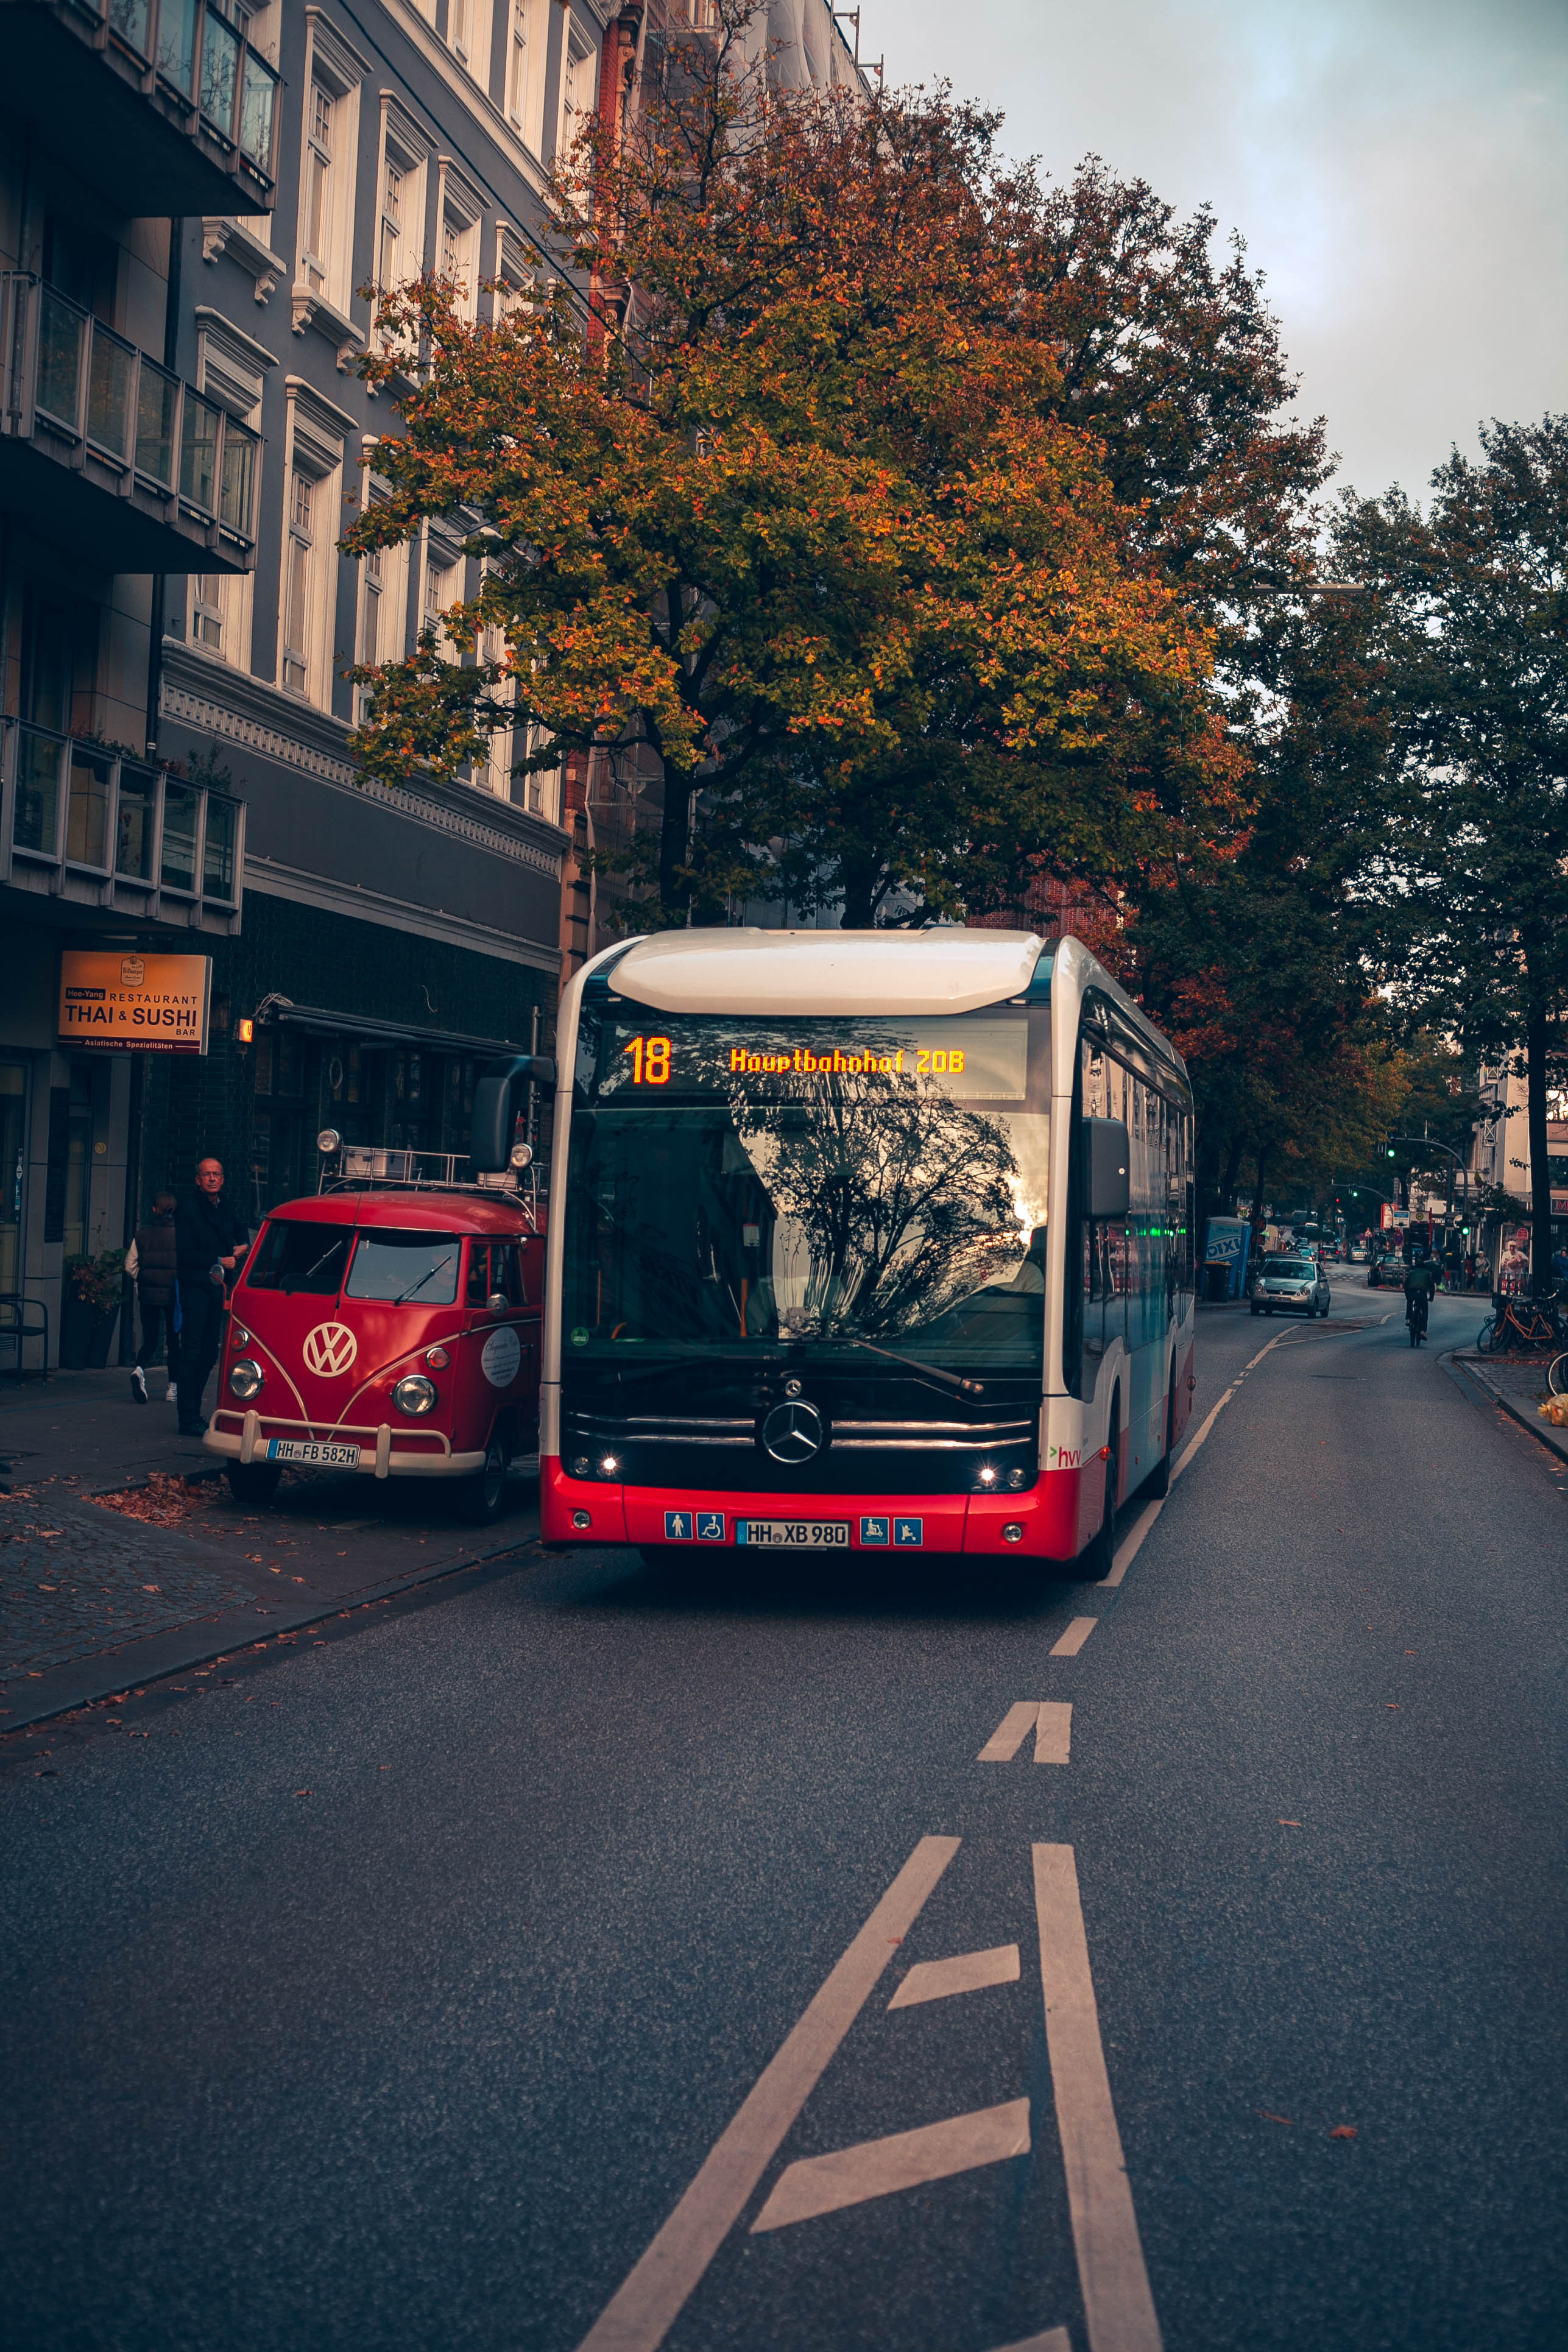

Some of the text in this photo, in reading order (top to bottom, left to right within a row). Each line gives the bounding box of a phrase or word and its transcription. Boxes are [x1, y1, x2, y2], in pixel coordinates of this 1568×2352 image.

[68, 990, 198, 1005] Hee-Yang RESTAURANT
[65, 1005, 197, 1027] THAI & SUSHI
[85, 1039, 173, 1050] Asiatische Spezialitäten
[624, 1036, 966, 1084] 18 Hauptbahnhof ZOB
[303, 1322, 357, 1377] VW
[277, 1443, 294, 1458] HH
[302, 1445, 319, 1460] FB
[322, 1446, 356, 1464] 582H
[747, 1524, 772, 1542] HH
[784, 1525, 808, 1543] XB
[811, 1525, 846, 1544] 980
